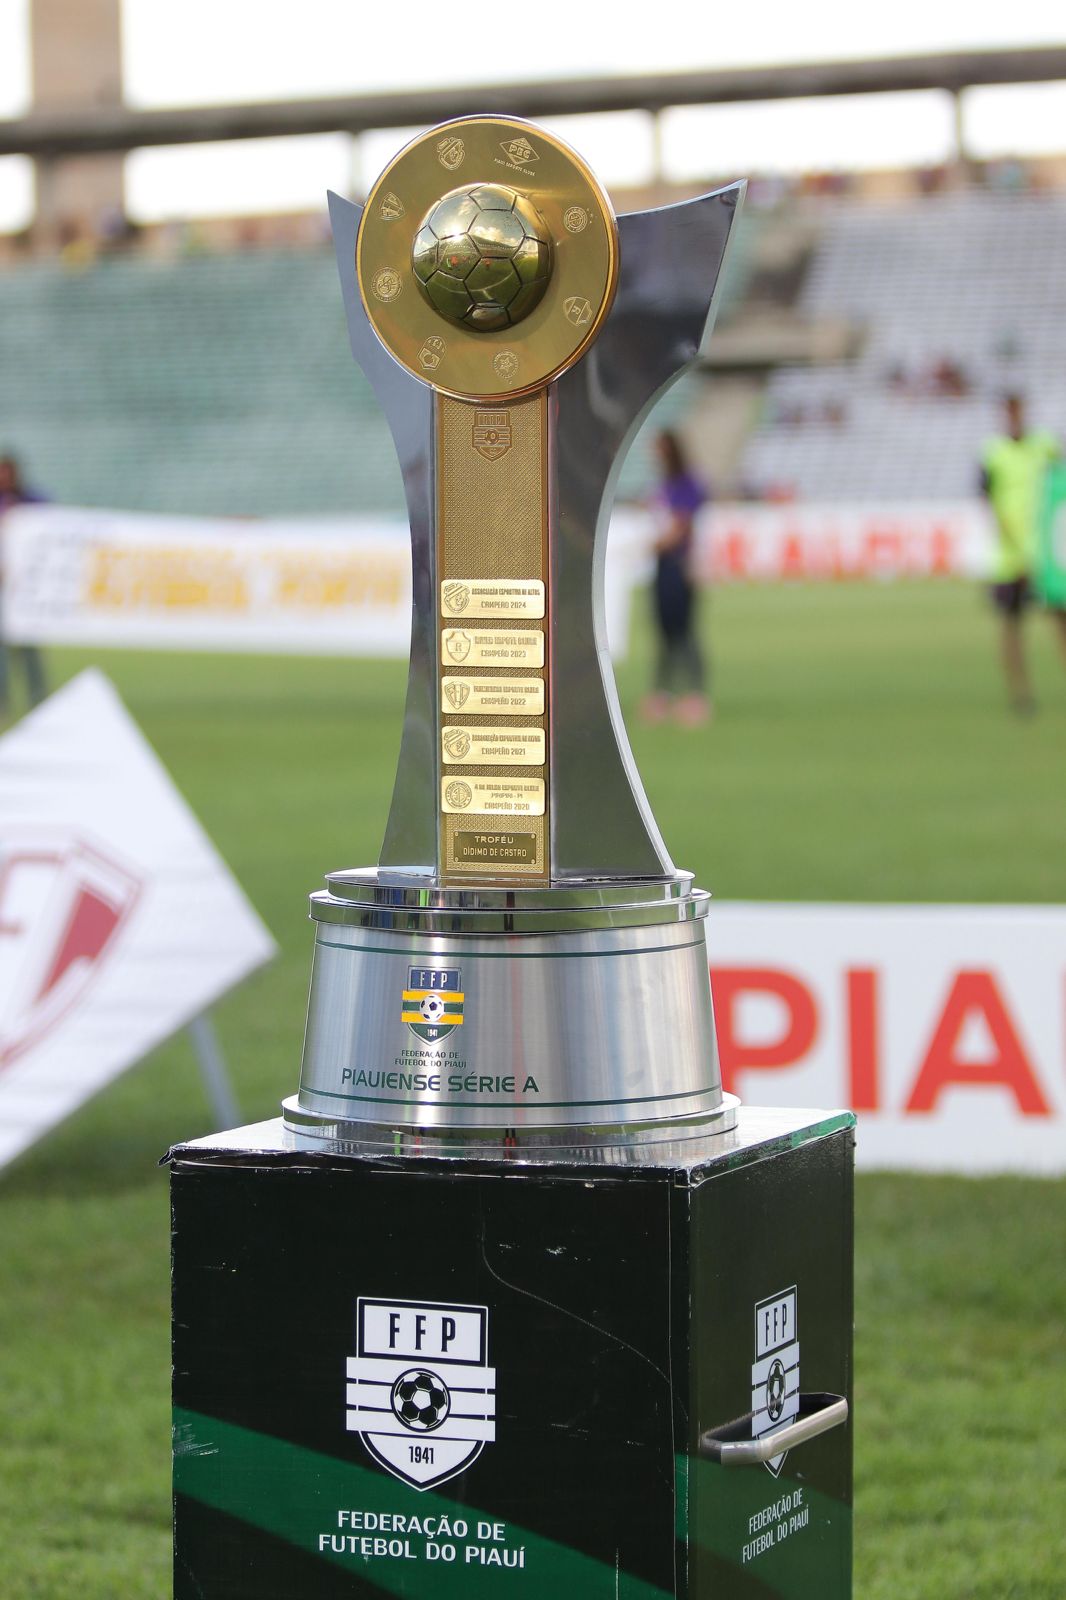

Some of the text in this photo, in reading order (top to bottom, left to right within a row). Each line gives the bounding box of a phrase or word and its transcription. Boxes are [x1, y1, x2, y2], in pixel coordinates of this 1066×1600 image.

[510, 601, 527, 609] 2024
[510, 649, 527, 658] 2023
[510, 697, 527, 706] 2022
[510, 747, 526, 756] 2021
[513, 802, 530, 811] 2020
[474, 835, 514, 844] TROFÉU
[463, 846, 488, 856] DÍDIMO
[489, 848, 498, 857] DE
[419, 971, 448, 988] FFP
[427, 1028, 438, 1037] 1941
[710, 966, 1066, 1115] PIA
[449, 1051, 459, 1059] DE
[394, 1058, 428, 1067] FUTEBOL
[430, 1059, 442, 1068] DO
[341, 1067, 540, 1093] PIAUIENSE SÉRIE A
[765, 1303, 788, 1347] FFP
[388, 1312, 456, 1353] FFP
[408, 1445, 435, 1465] 1941
[748, 1487, 804, 1536] FEDERAÇÃO DE
[337, 1509, 506, 1542] FEDERAÇÃO DE
[742, 1504, 810, 1564] FUTEBOL DO PIAUÍ
[318, 1533, 526, 1568] FUTEBOL DO PIAUÍ
